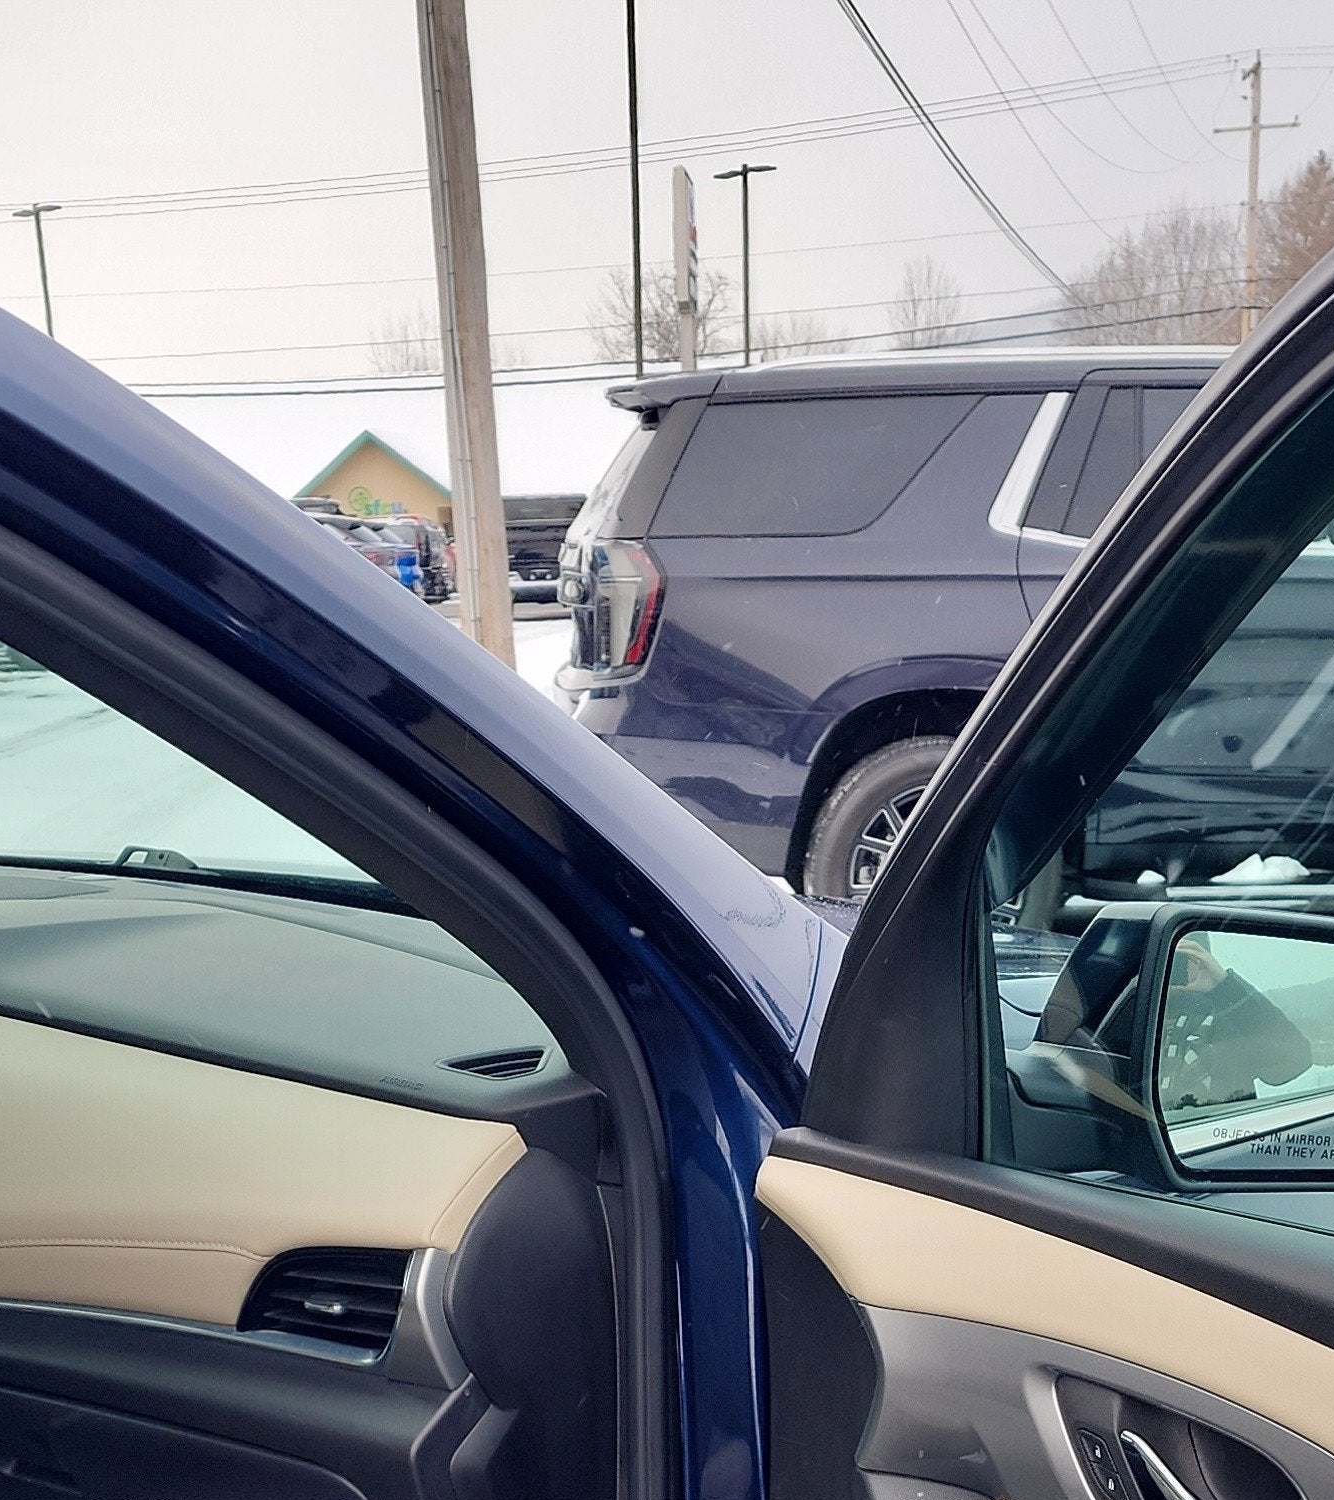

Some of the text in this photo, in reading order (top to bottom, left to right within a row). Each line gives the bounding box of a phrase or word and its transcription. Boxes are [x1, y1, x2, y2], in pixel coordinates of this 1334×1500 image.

[1212, 1127, 1266, 1143] OBJEC
[1269, 1132, 1282, 1144] IN
[1286, 1134, 1331, 1147] MIRROR
[1250, 1143, 1281, 1156] THAN
[1286, 1146, 1315, 1158] THEY
